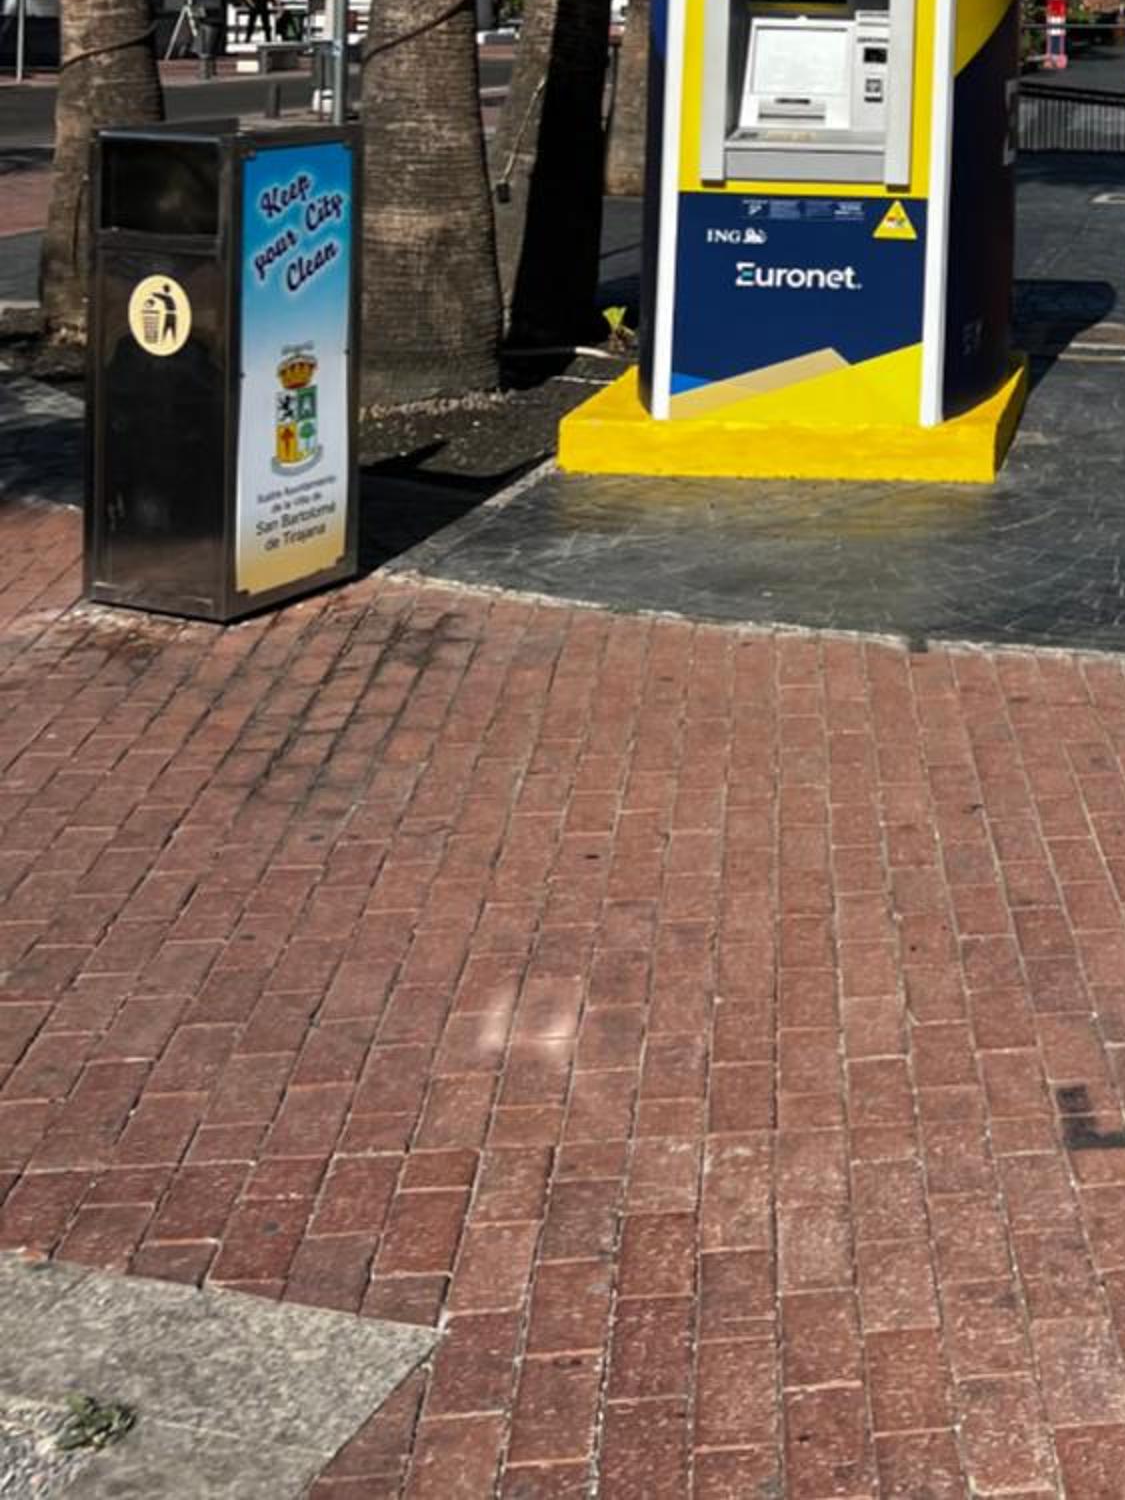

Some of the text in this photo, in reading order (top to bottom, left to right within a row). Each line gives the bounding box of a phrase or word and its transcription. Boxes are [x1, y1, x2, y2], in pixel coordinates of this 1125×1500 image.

[261, 175, 309, 218] Keep
[305, 194, 342, 231] City
[706, 228, 741, 243] ING
[287, 243, 336, 291] Clean
[256, 519, 279, 536] San
